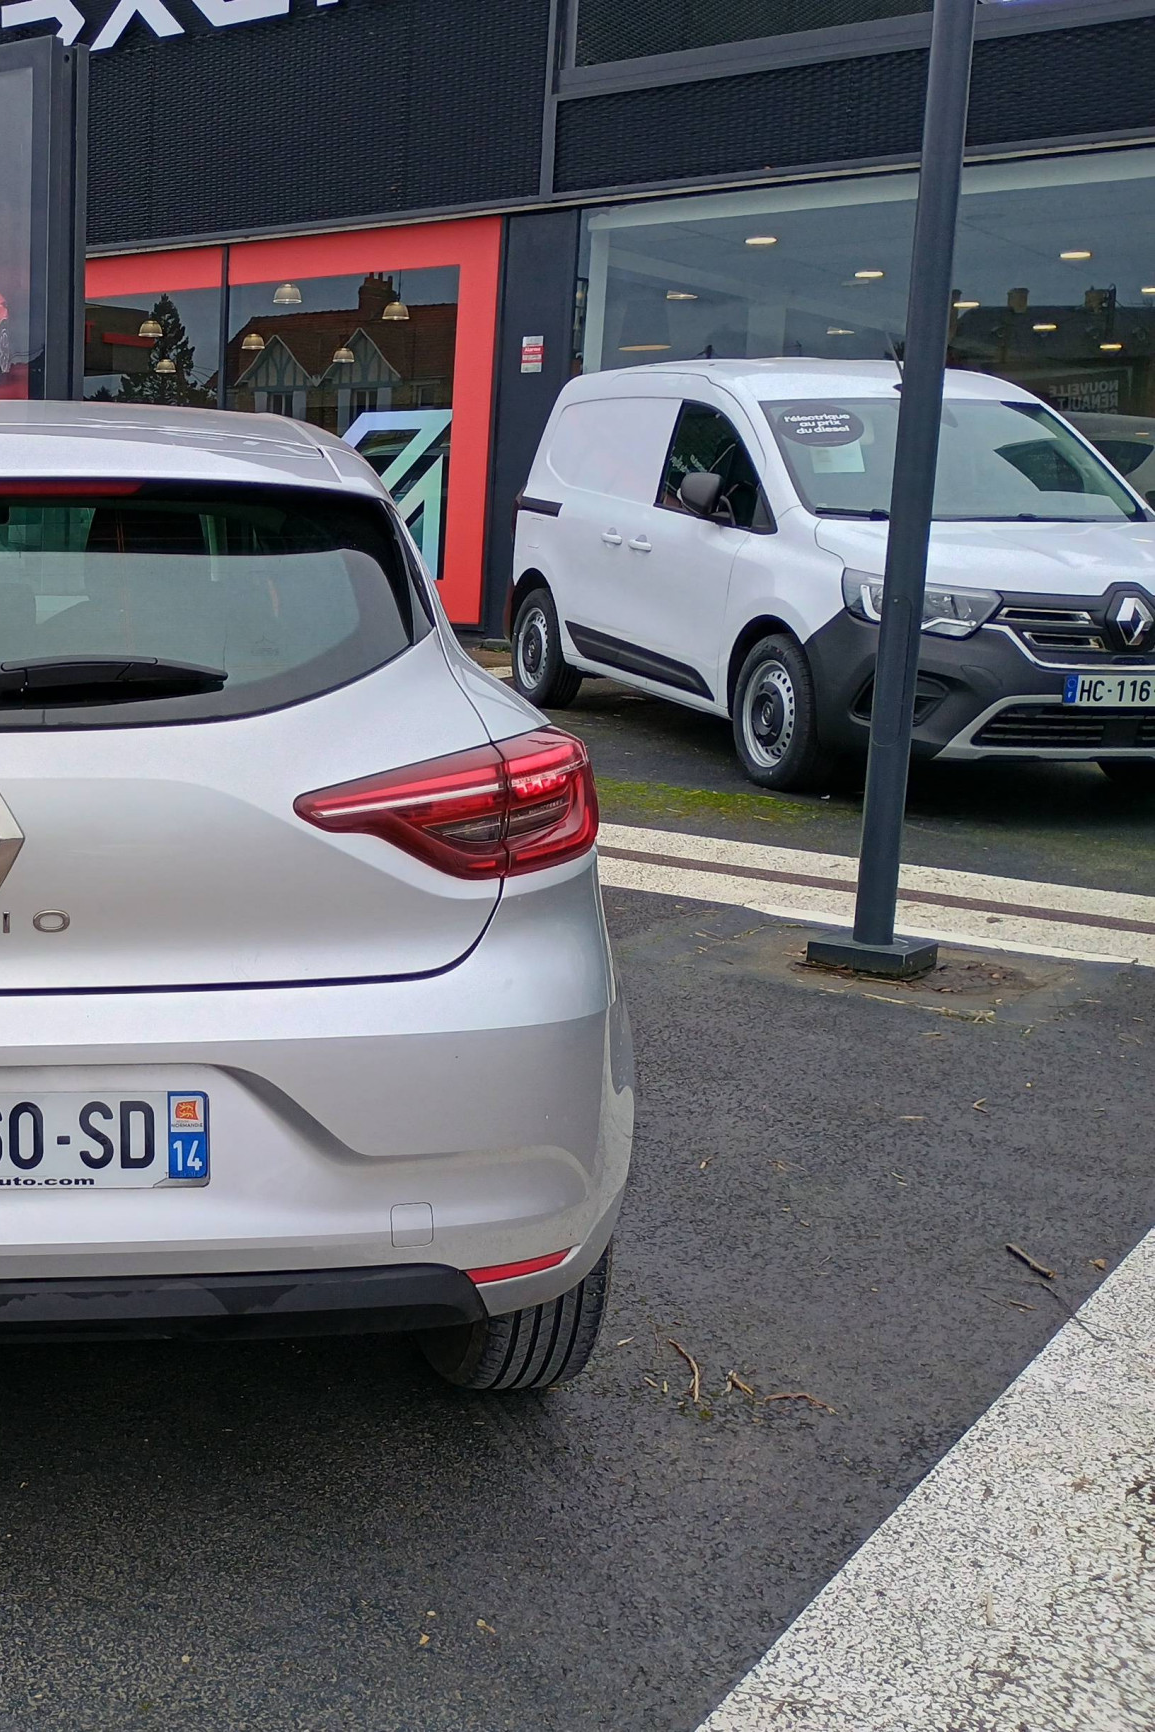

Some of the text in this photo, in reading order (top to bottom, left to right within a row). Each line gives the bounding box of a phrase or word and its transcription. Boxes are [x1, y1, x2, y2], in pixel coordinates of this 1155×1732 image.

[814, 425, 850, 433] diesel
[1079, 680, 1155, 702] HC-116
[173, 1140, 203, 1171] 14
